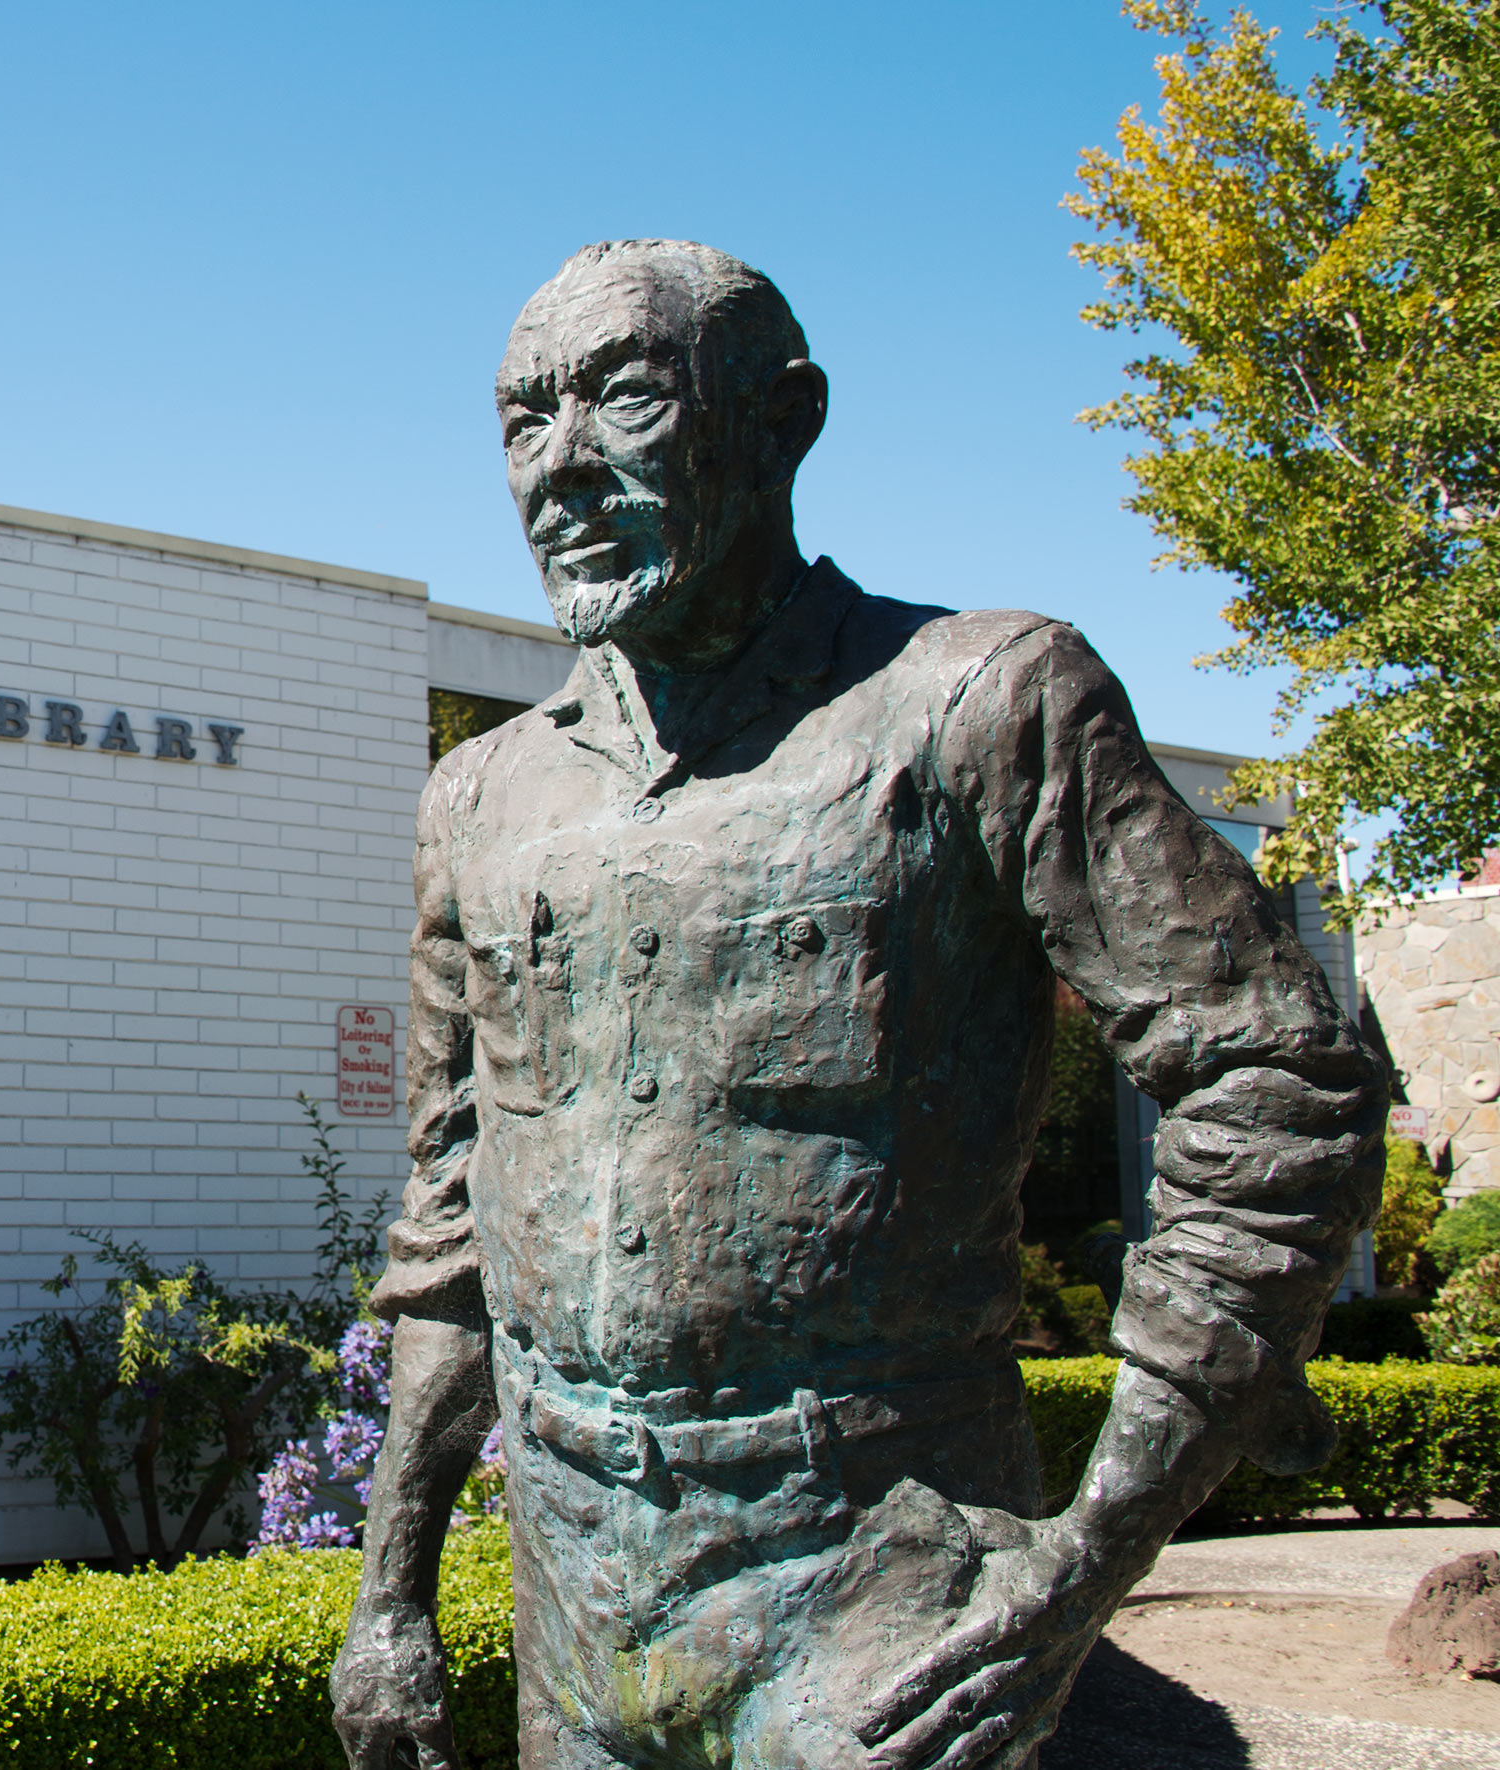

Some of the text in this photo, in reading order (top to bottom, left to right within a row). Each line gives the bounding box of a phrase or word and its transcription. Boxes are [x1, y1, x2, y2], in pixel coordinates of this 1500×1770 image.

[355, 1010, 375, 1025] No
[341, 1027, 392, 1047] Loitering
[358, 1045, 372, 1055] Or
[341, 1058, 390, 1077] Smoking
[340, 1080, 355, 1096] City
[357, 1080, 365, 1093] of
